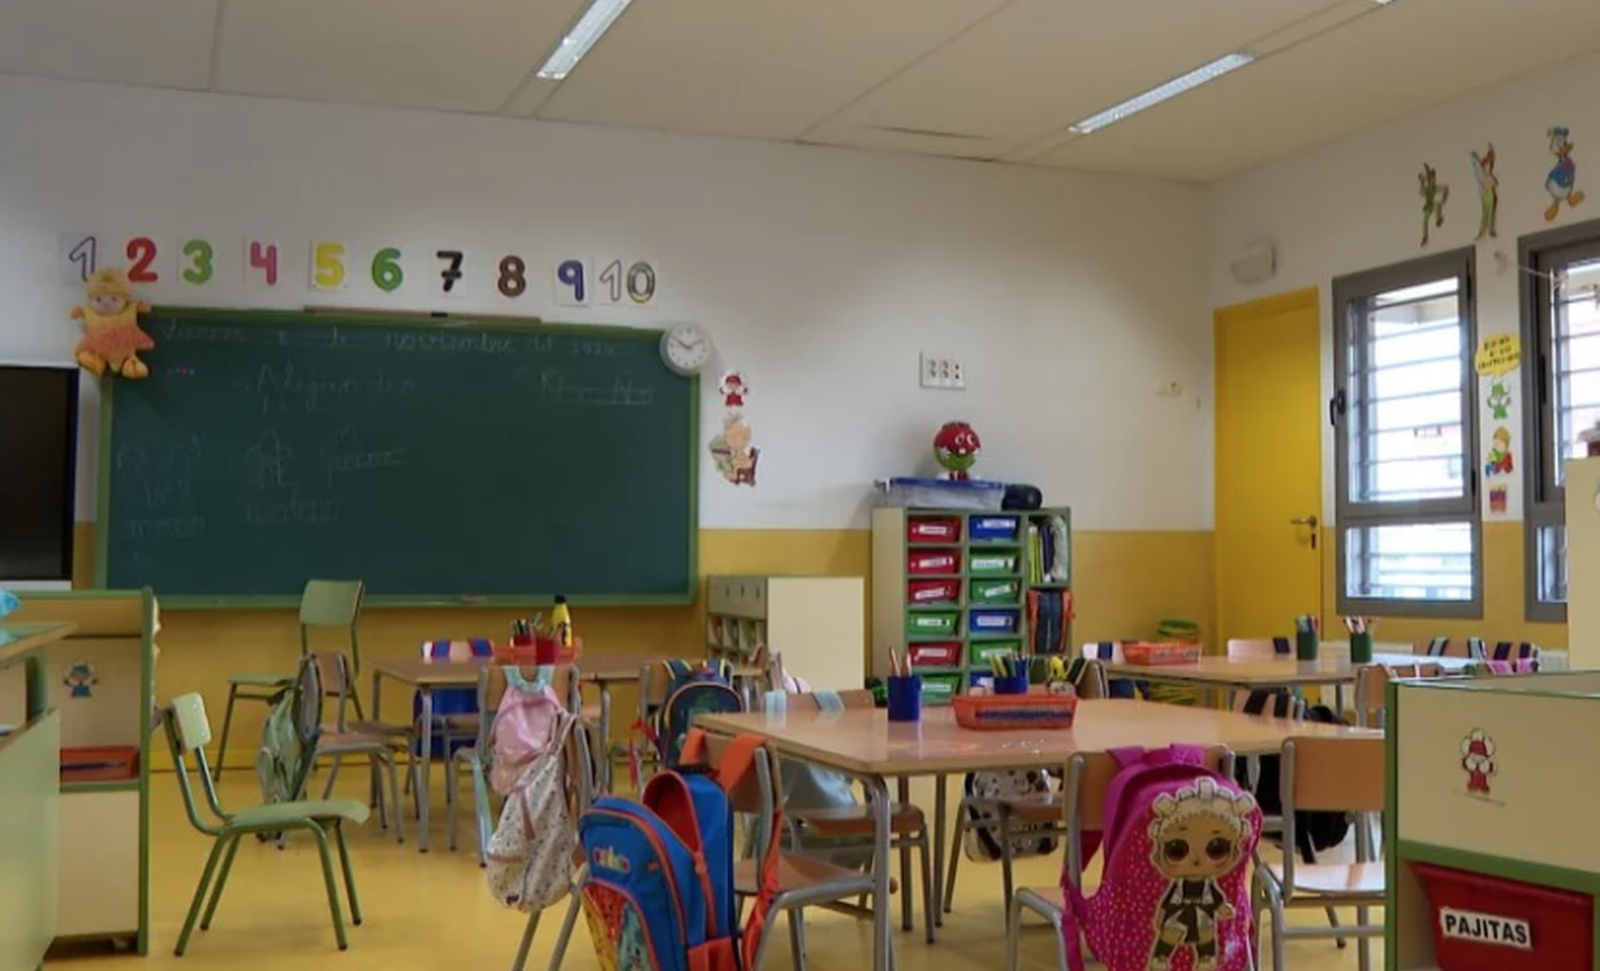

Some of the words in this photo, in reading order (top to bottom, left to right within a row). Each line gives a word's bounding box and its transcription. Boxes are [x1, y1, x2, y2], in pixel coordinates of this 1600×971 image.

[69, 236, 97, 282] 1
[126, 237, 158, 282] 2
[182, 239, 213, 284] 3
[250, 241, 277, 286] 4
[315, 242, 344, 287] 5
[371, 247, 403, 292] 6
[436, 250, 463, 292] 7
[497, 255, 526, 297] 8
[557, 260, 584, 301] 9
[600, 260, 656, 303] 10
[1444, 913, 1528, 944] PAJITAS
